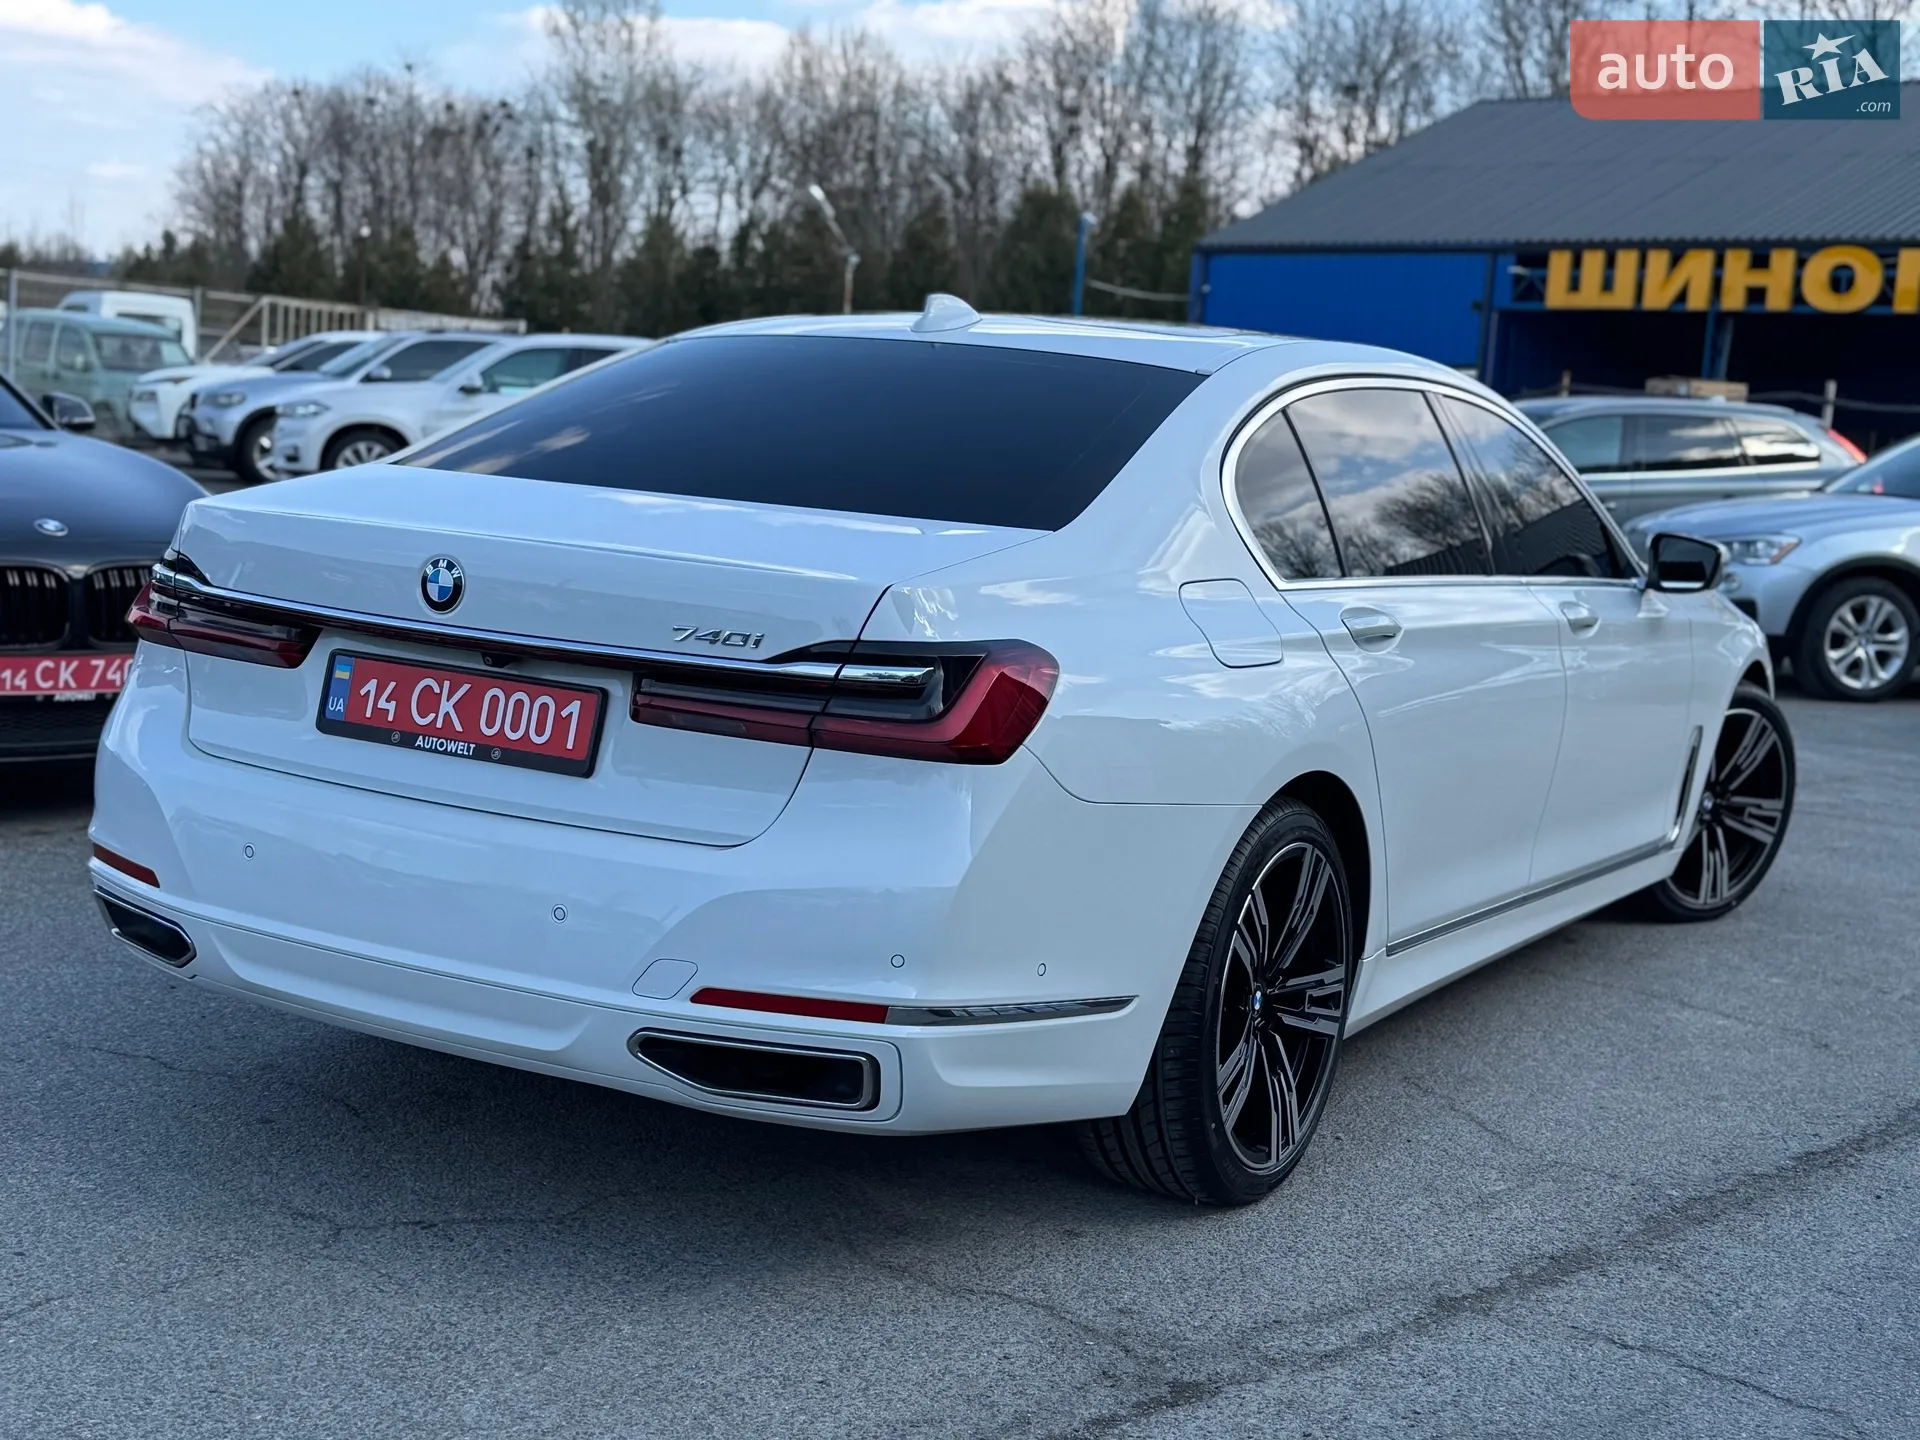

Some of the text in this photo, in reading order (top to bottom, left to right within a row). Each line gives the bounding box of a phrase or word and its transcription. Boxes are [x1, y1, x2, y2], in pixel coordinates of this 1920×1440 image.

[426, 559, 461, 578] BMW
[672, 625, 765, 649] 740i
[0, 668, 28, 691] 14
[35, 660, 79, 689] CK
[328, 696, 345, 713] UA
[359, 677, 582, 750] 14 CK 0001
[415, 735, 476, 756] AUTOWELT
